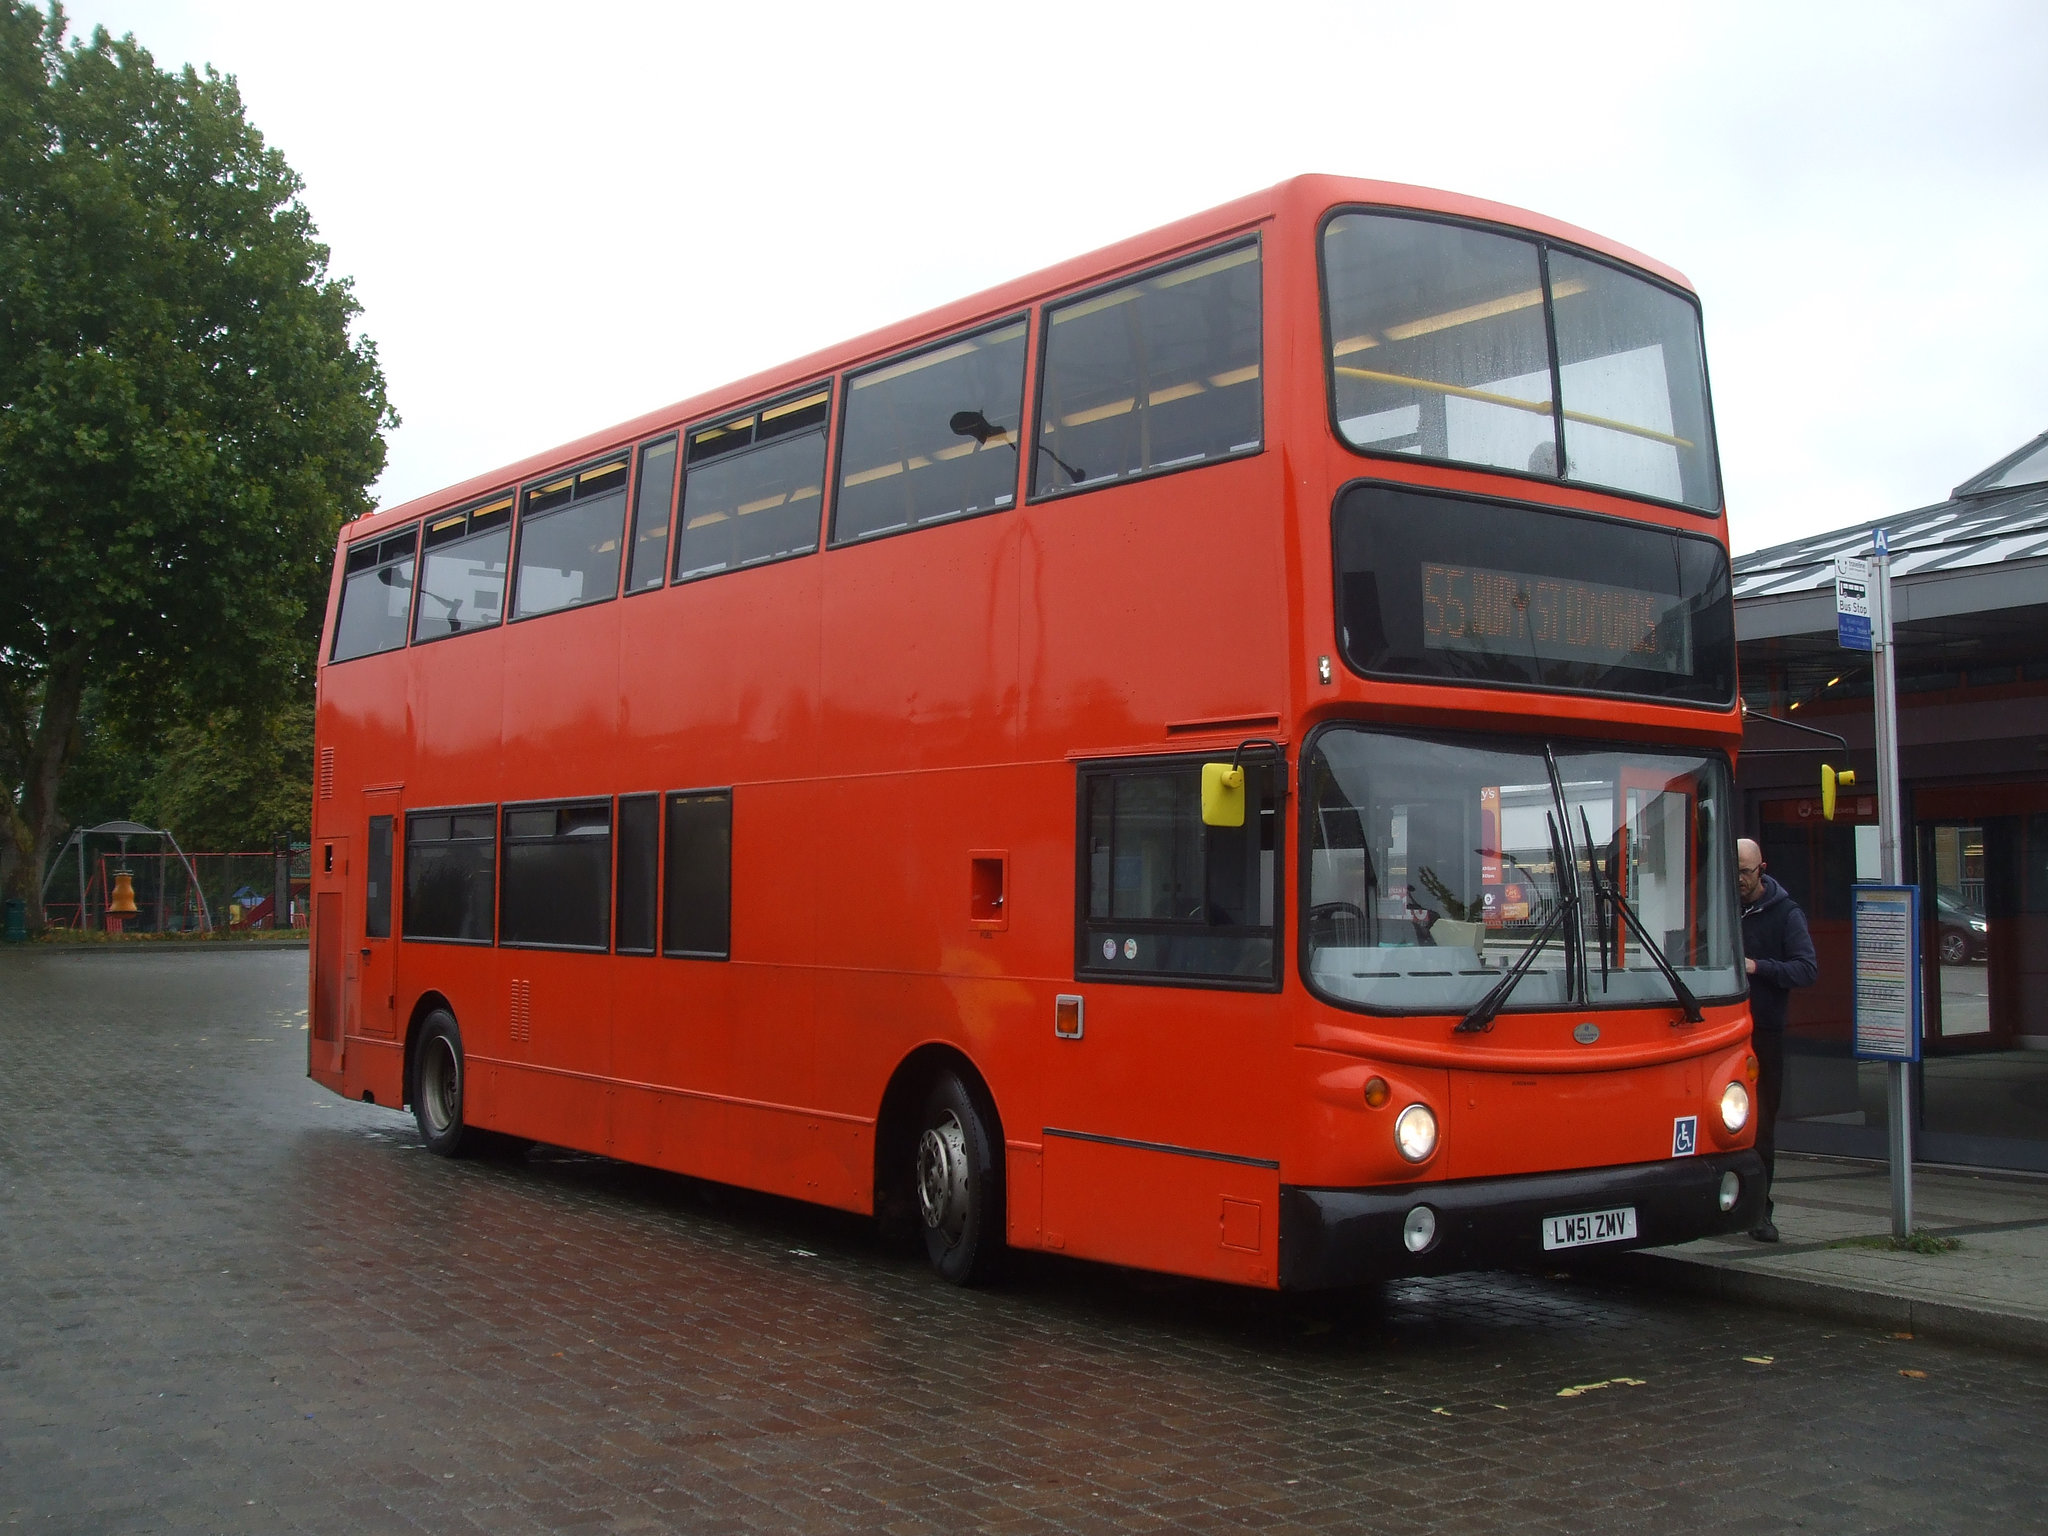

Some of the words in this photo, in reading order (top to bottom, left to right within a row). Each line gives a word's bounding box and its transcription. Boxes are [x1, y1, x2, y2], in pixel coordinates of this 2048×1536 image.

[1875, 531, 1887, 550] A
[1424, 565, 1466, 640] 55
[1839, 600, 1852, 613] Bus
[1852, 602, 1868, 616] Stop
[1554, 1216, 1592, 1244] LW51
[1595, 1211, 1625, 1238] ZMV
